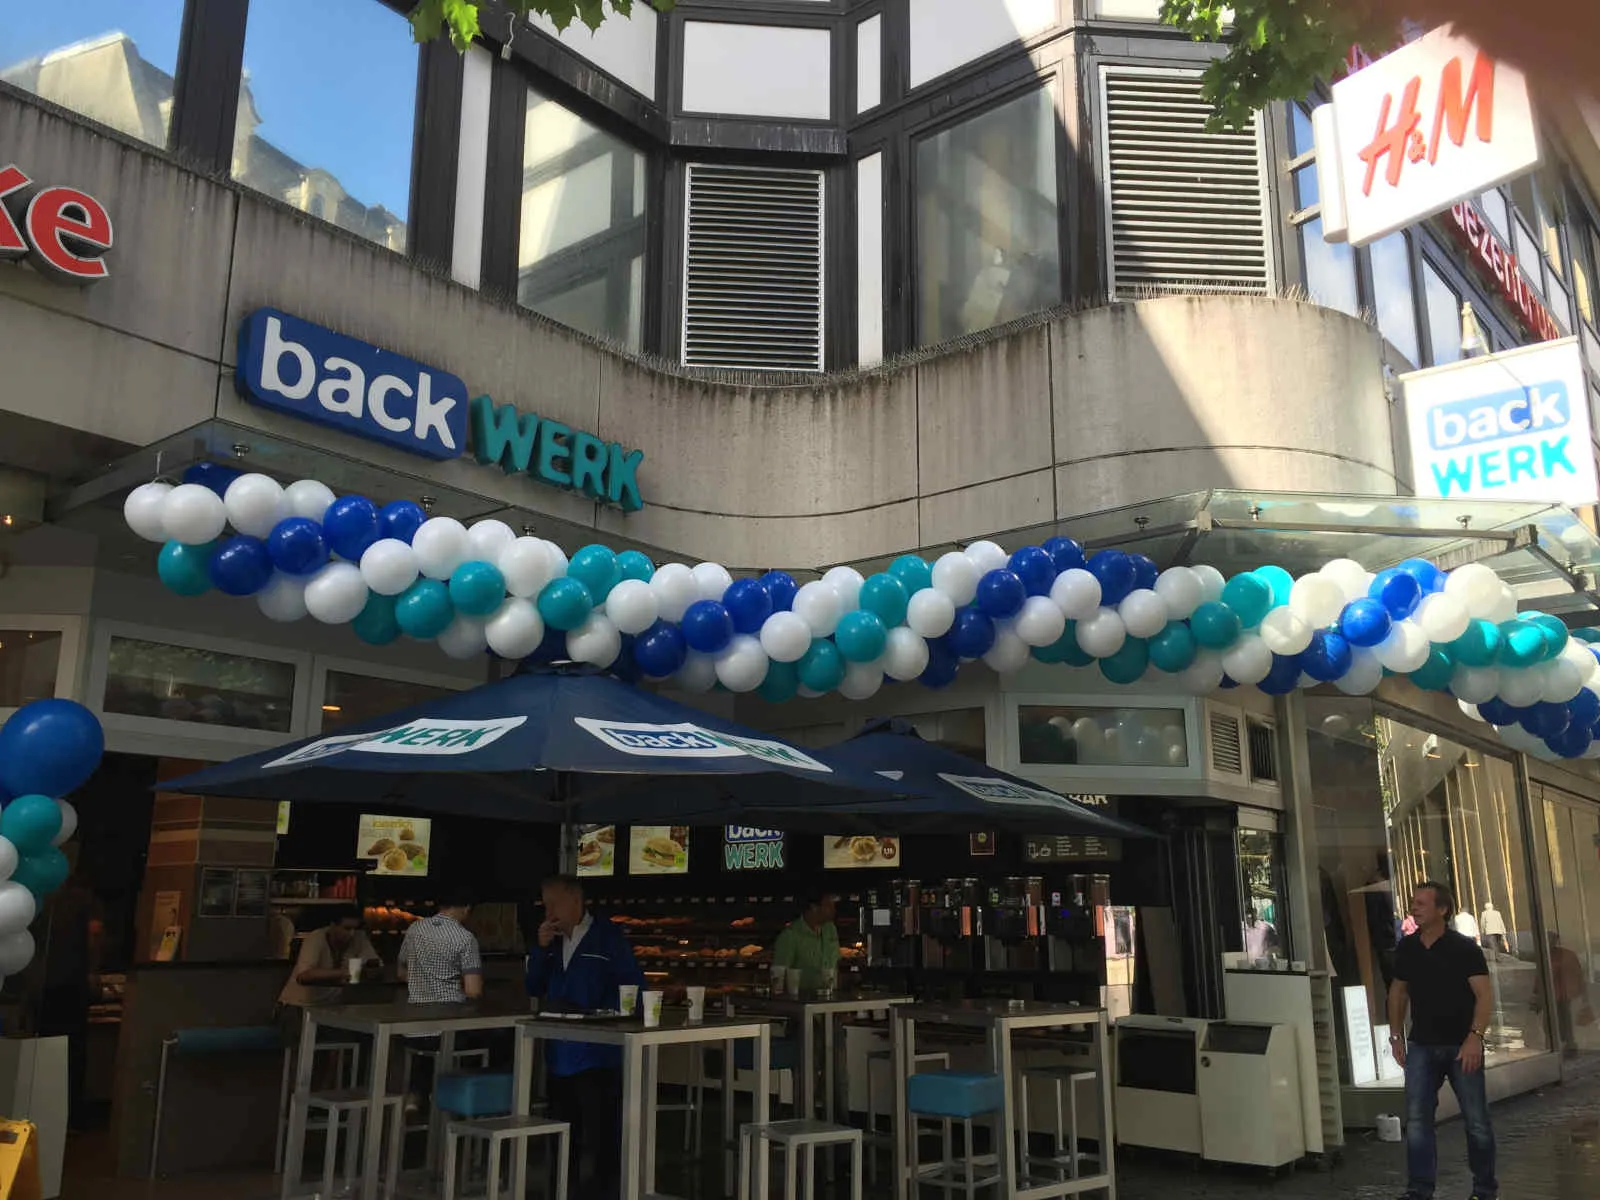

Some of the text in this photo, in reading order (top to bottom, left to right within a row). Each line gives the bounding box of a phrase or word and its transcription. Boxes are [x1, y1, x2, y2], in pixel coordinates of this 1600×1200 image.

[1358, 48, 1496, 197] H&M
[261, 316, 644, 511] back WERK
[1432, 387, 1565, 447] back
[1430, 435, 1577, 499] WERK
[614, 729, 712, 749] back
[725, 842, 784, 869] WERK
